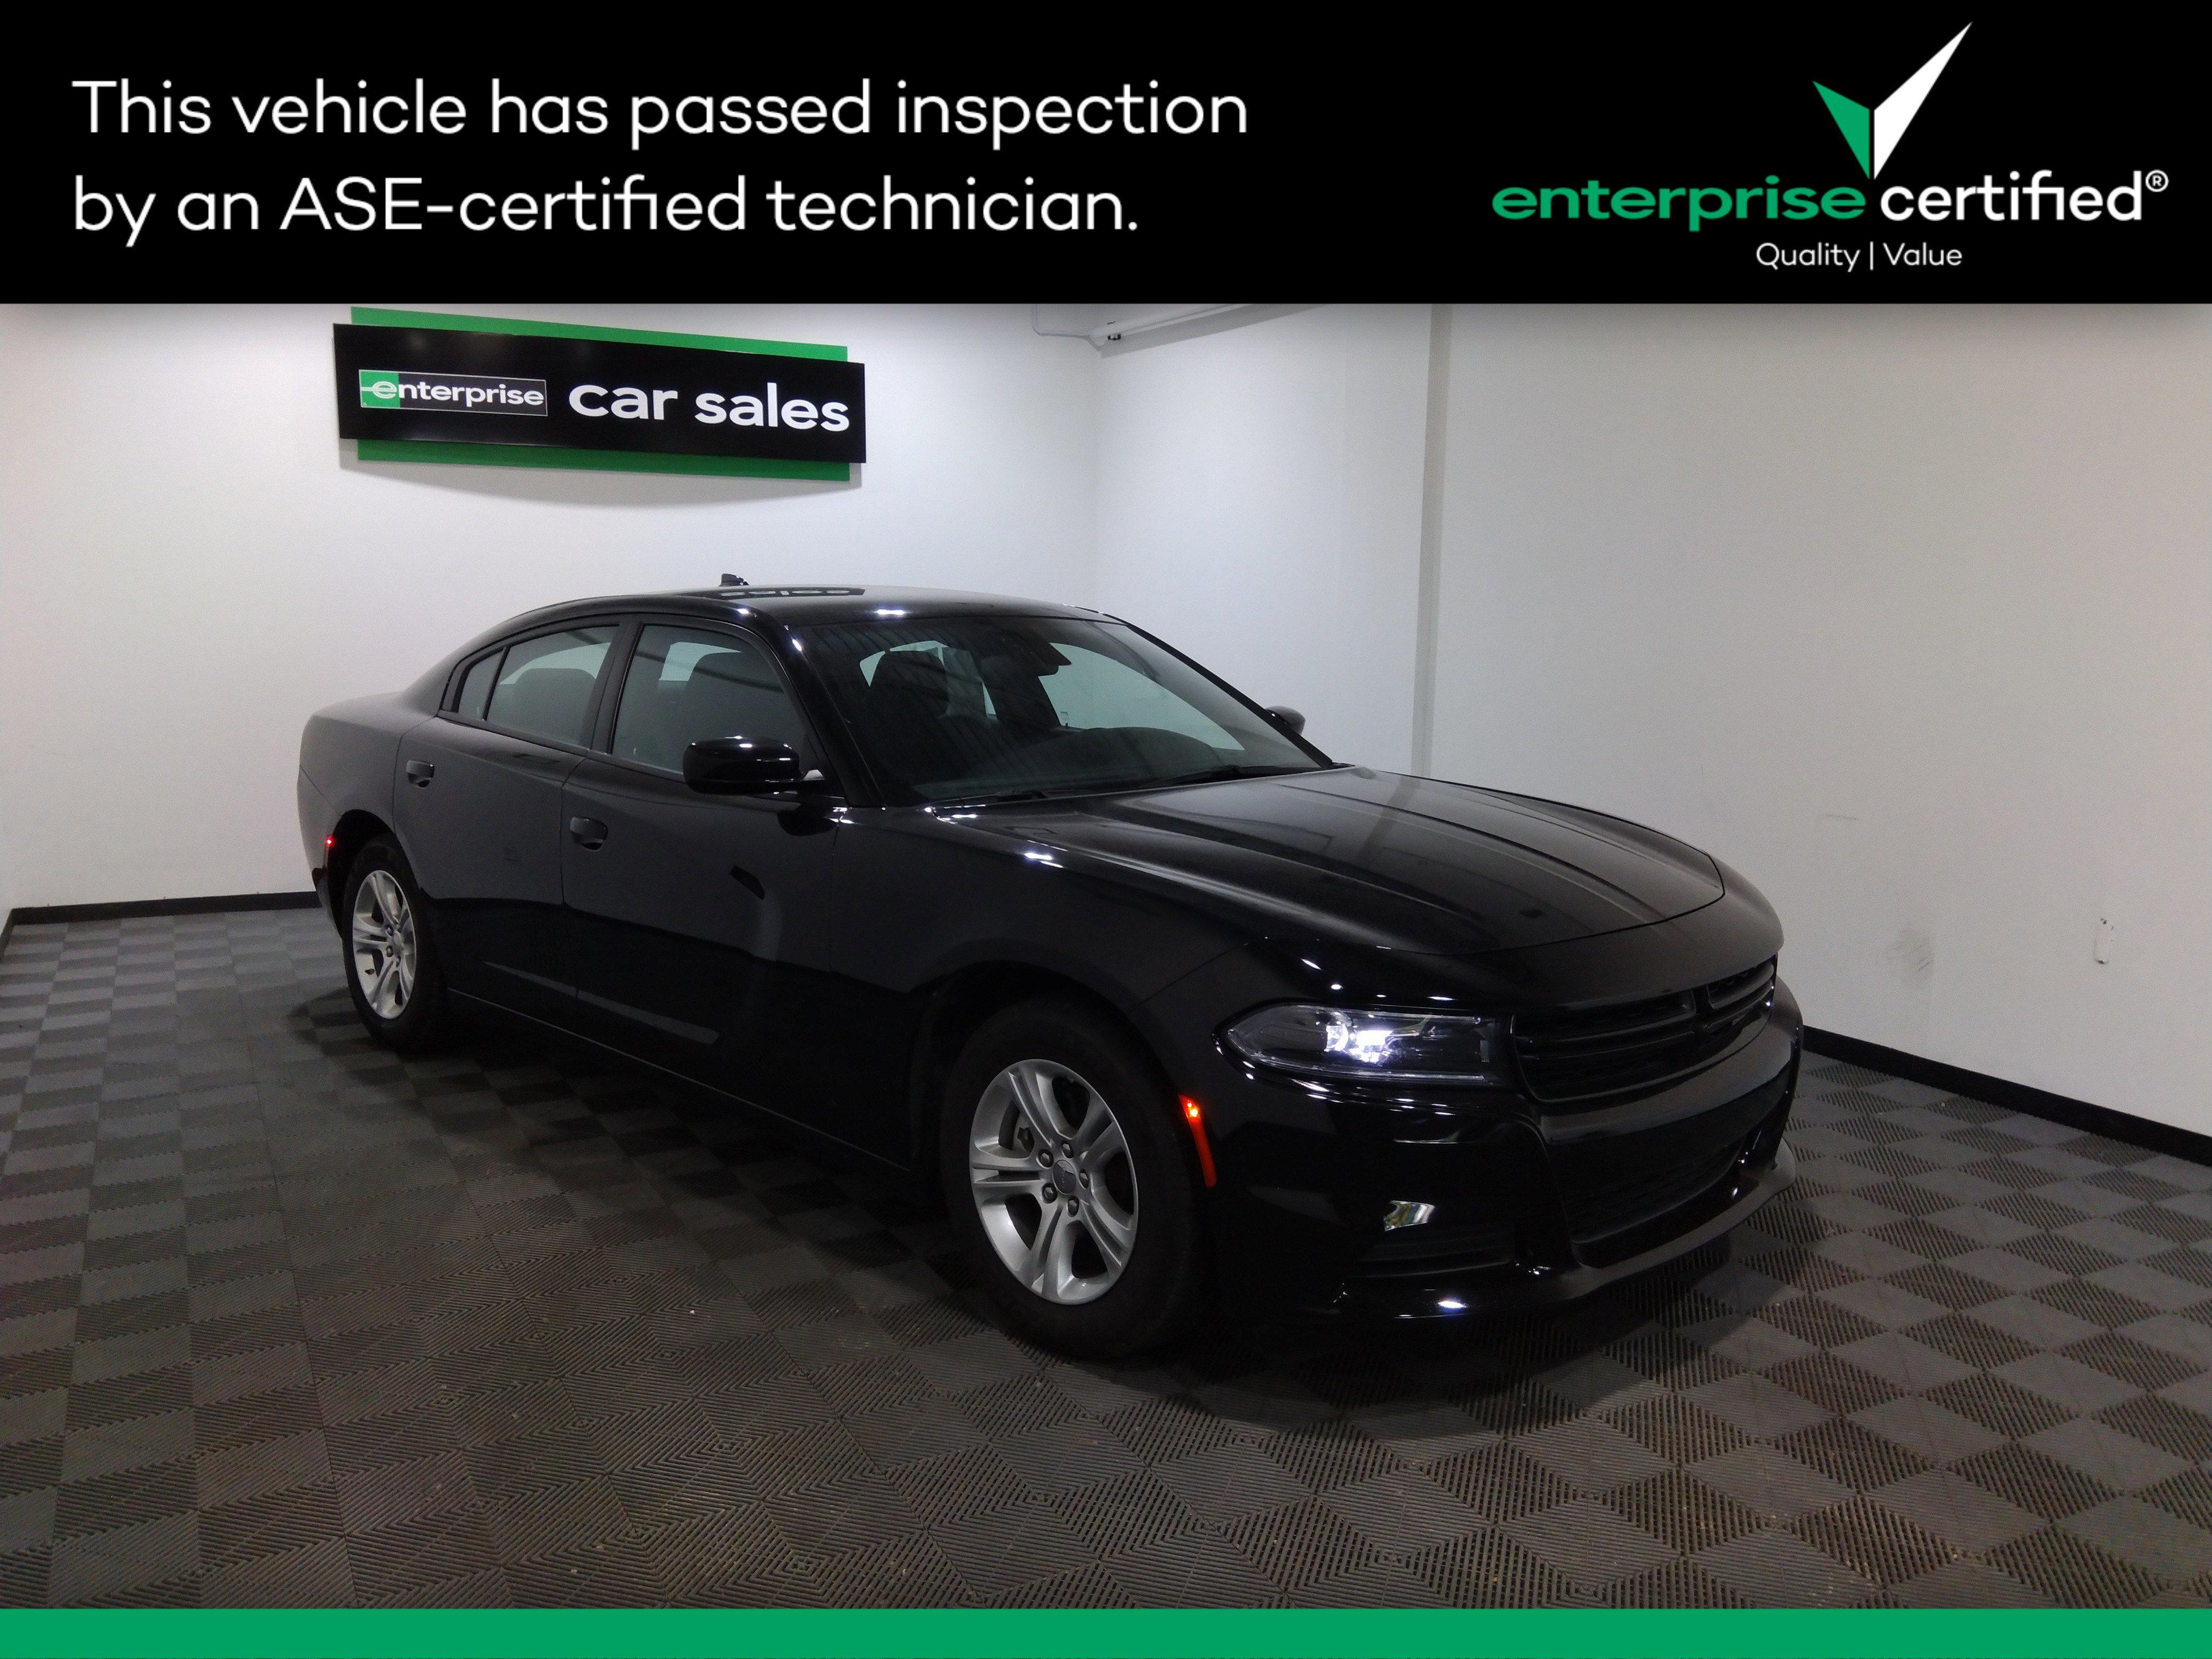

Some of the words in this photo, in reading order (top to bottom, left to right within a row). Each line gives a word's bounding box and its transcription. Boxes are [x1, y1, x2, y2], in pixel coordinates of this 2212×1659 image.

[363, 380, 544, 408] enterprise
[568, 383, 678, 420] car
[694, 382, 850, 432] sales
